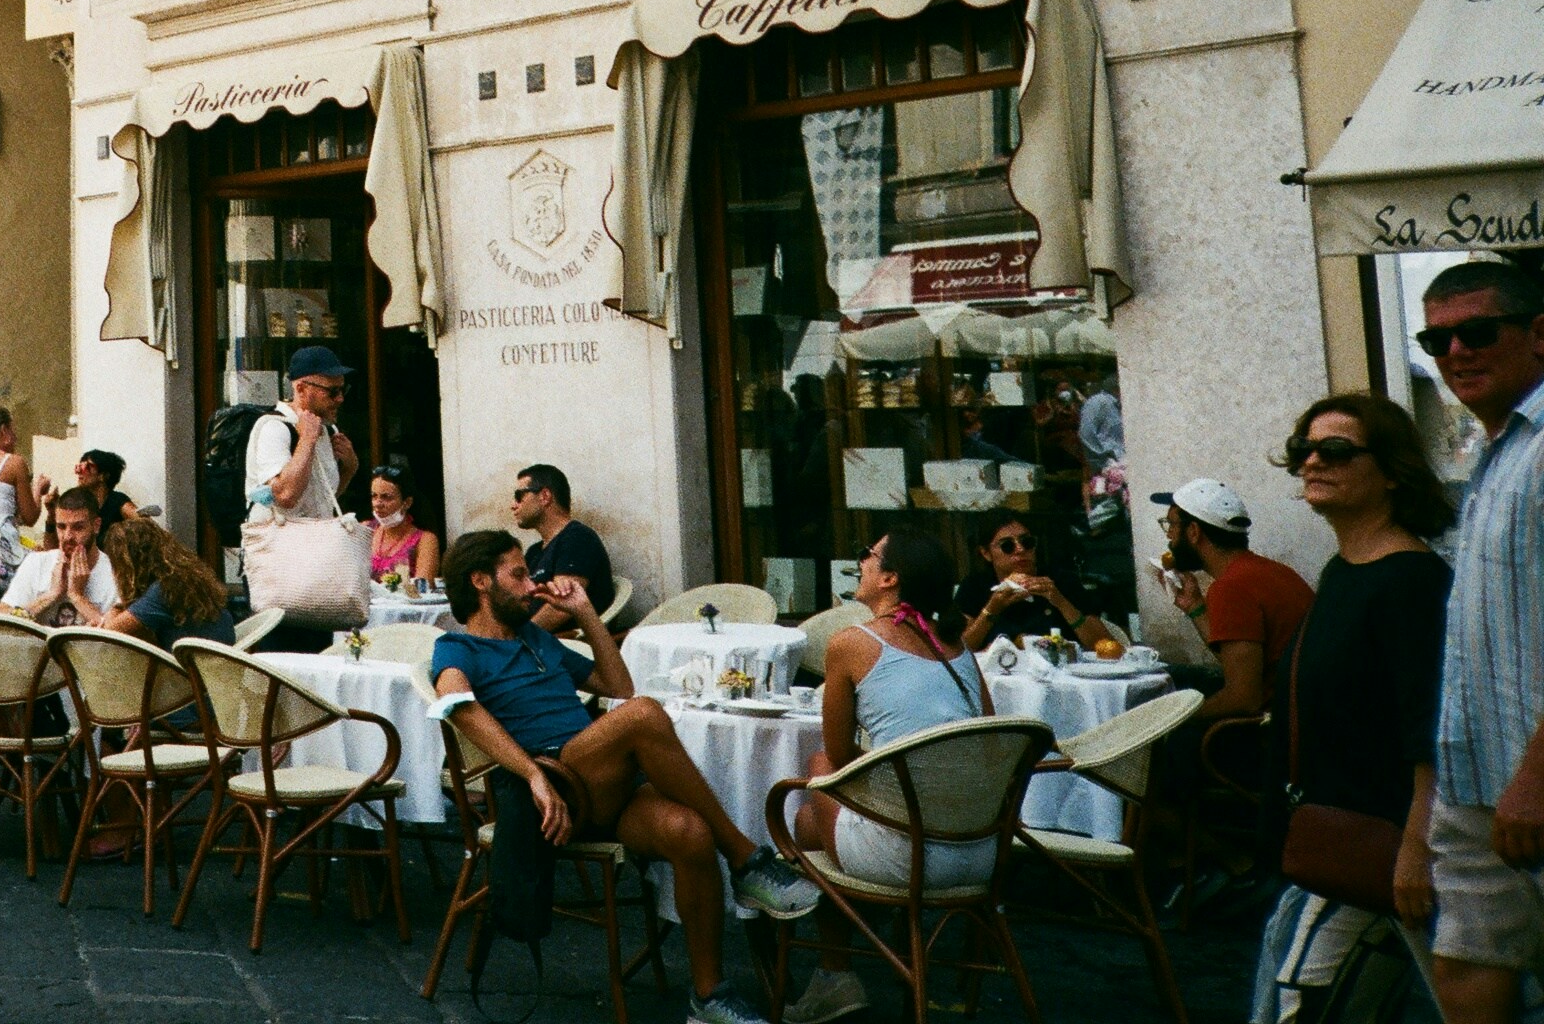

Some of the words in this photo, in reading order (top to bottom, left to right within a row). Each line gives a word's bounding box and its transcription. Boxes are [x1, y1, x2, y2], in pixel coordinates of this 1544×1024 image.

[172, 74, 329, 117] Pasticceria
[1371, 204, 1427, 248] La
[1434, 192, 1544, 245] Scud
[486, 238, 512, 275] CASA
[459, 304, 556, 330] PASTICCERIA
[501, 339, 600, 366] CONFETTURE
